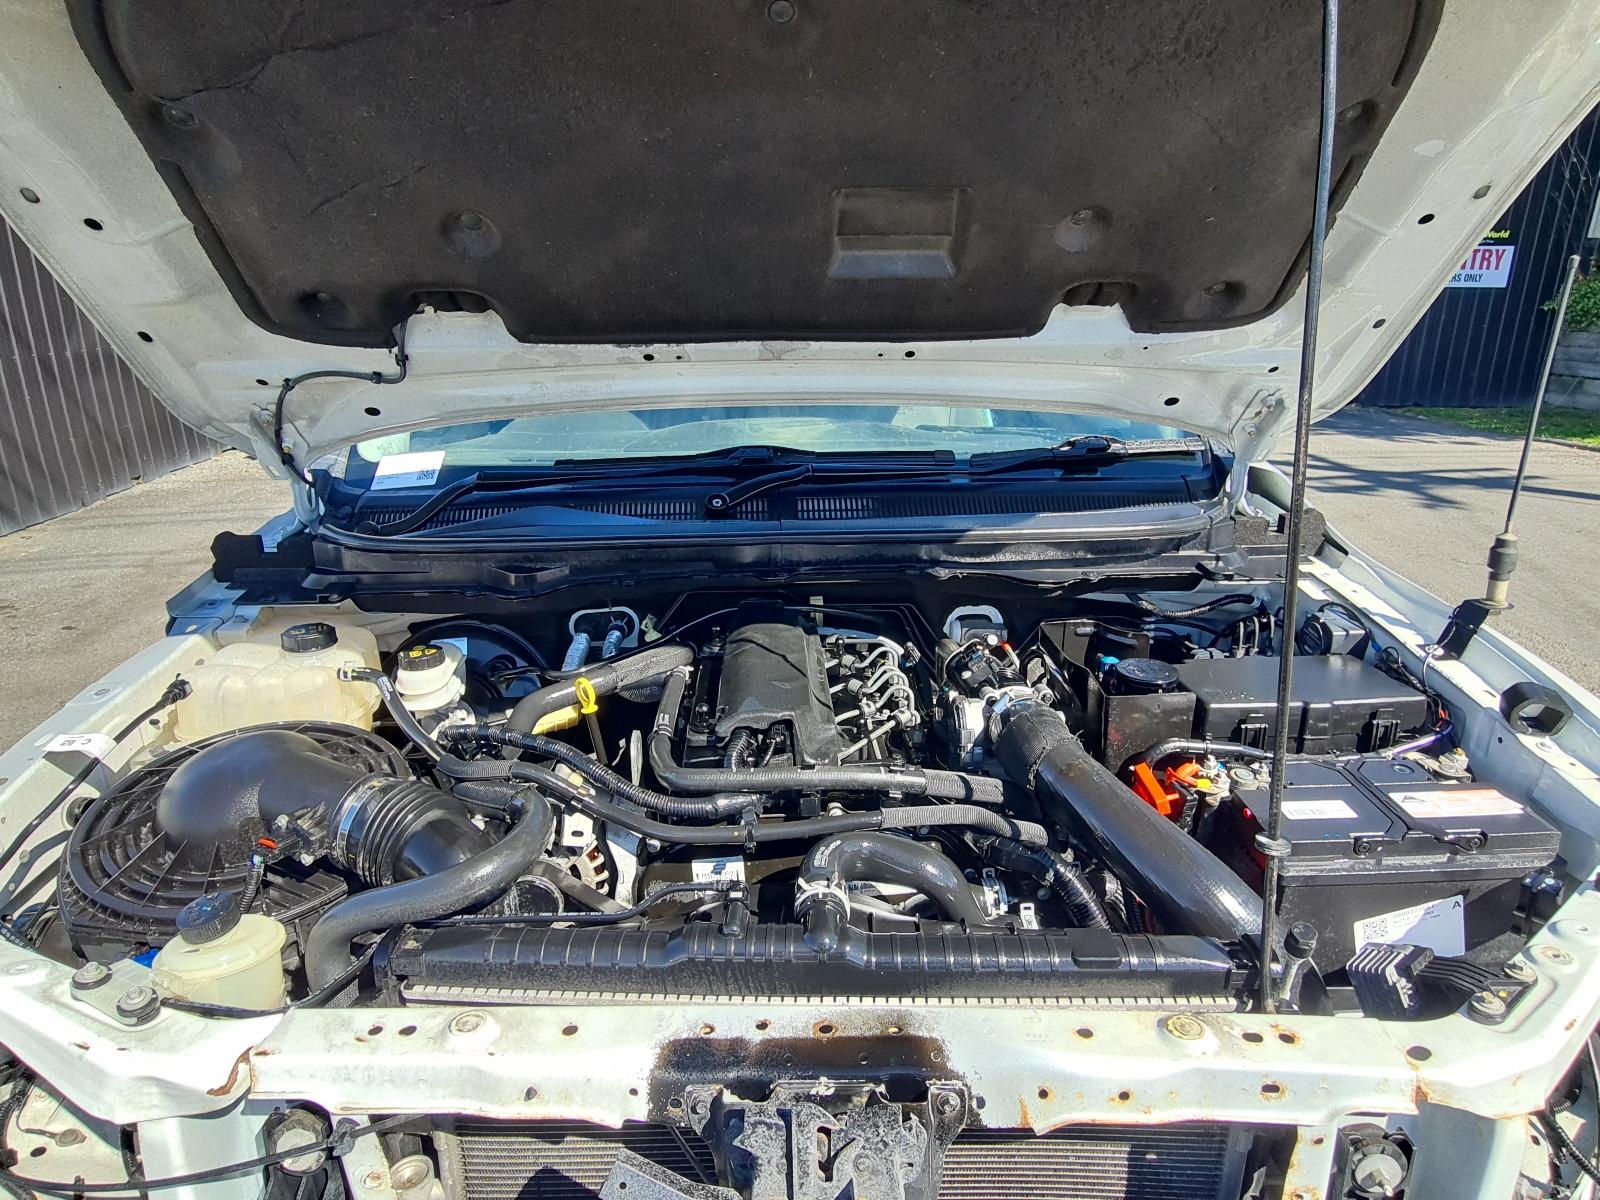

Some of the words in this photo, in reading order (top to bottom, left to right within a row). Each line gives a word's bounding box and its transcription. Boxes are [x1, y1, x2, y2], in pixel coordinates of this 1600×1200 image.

[1461, 249, 1507, 270] TRY
[1464, 274, 1483, 282] ONLY
[1452, 900, 1462, 910] A
